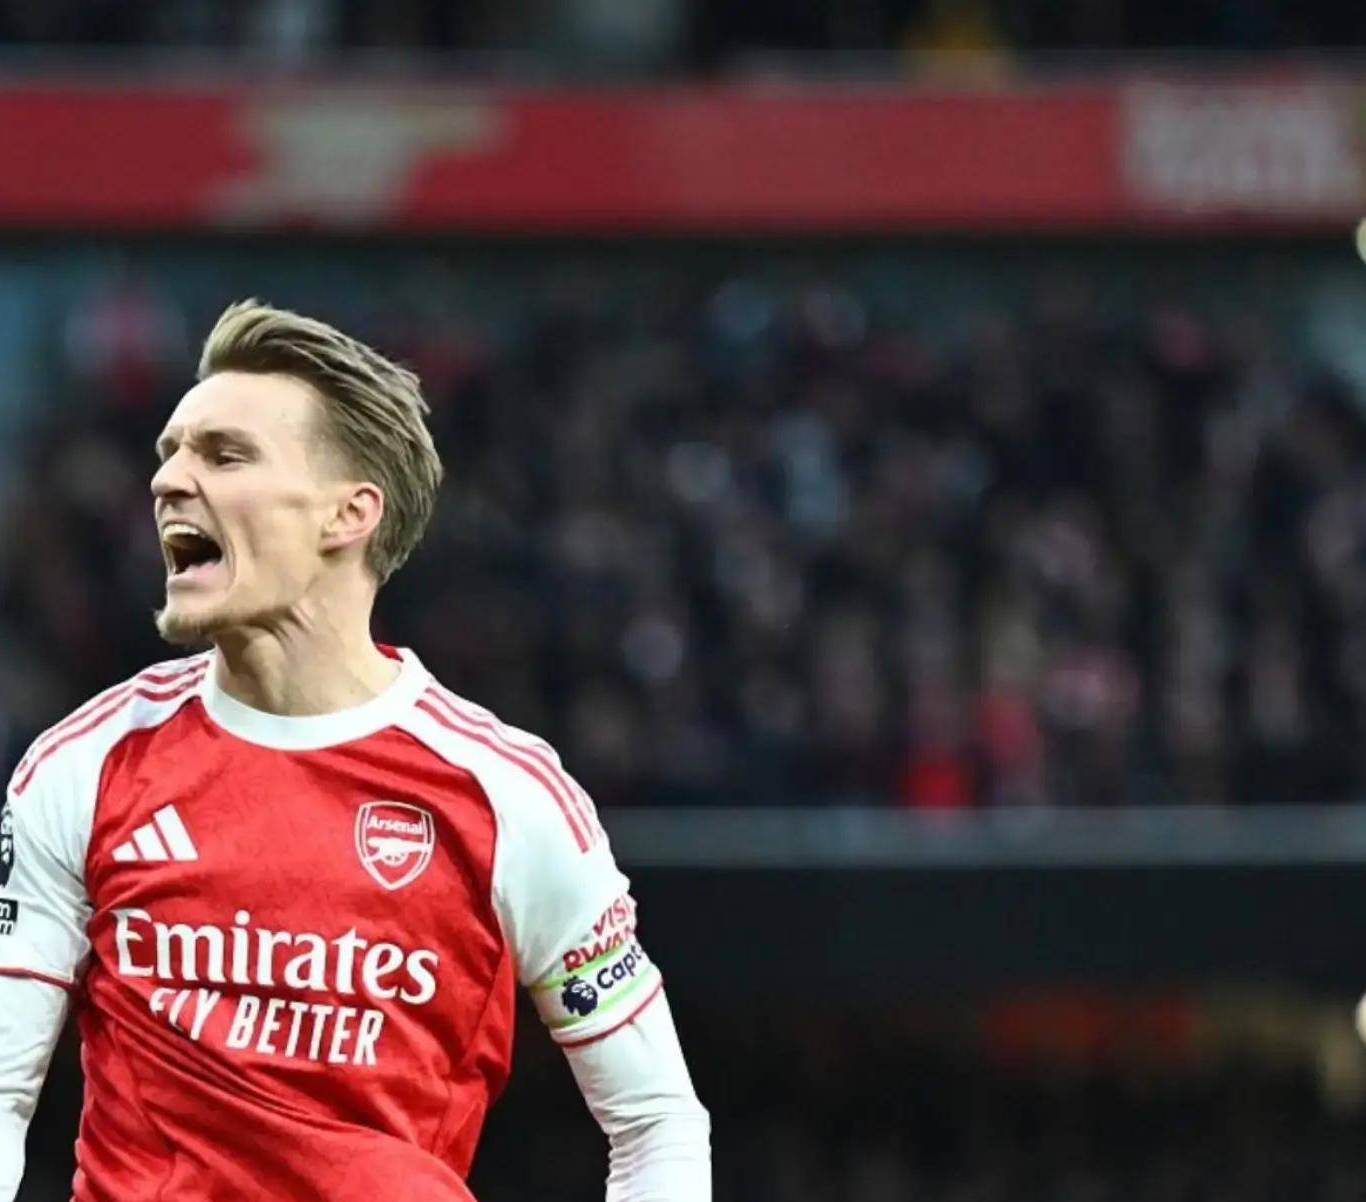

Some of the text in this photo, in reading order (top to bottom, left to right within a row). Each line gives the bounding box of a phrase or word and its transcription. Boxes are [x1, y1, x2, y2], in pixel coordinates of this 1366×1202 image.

[592, 893, 633, 936] VISI
[110, 907, 440, 1005] Emirates
[597, 945, 642, 989] Capt
[226, 993, 384, 1067] BETTER
